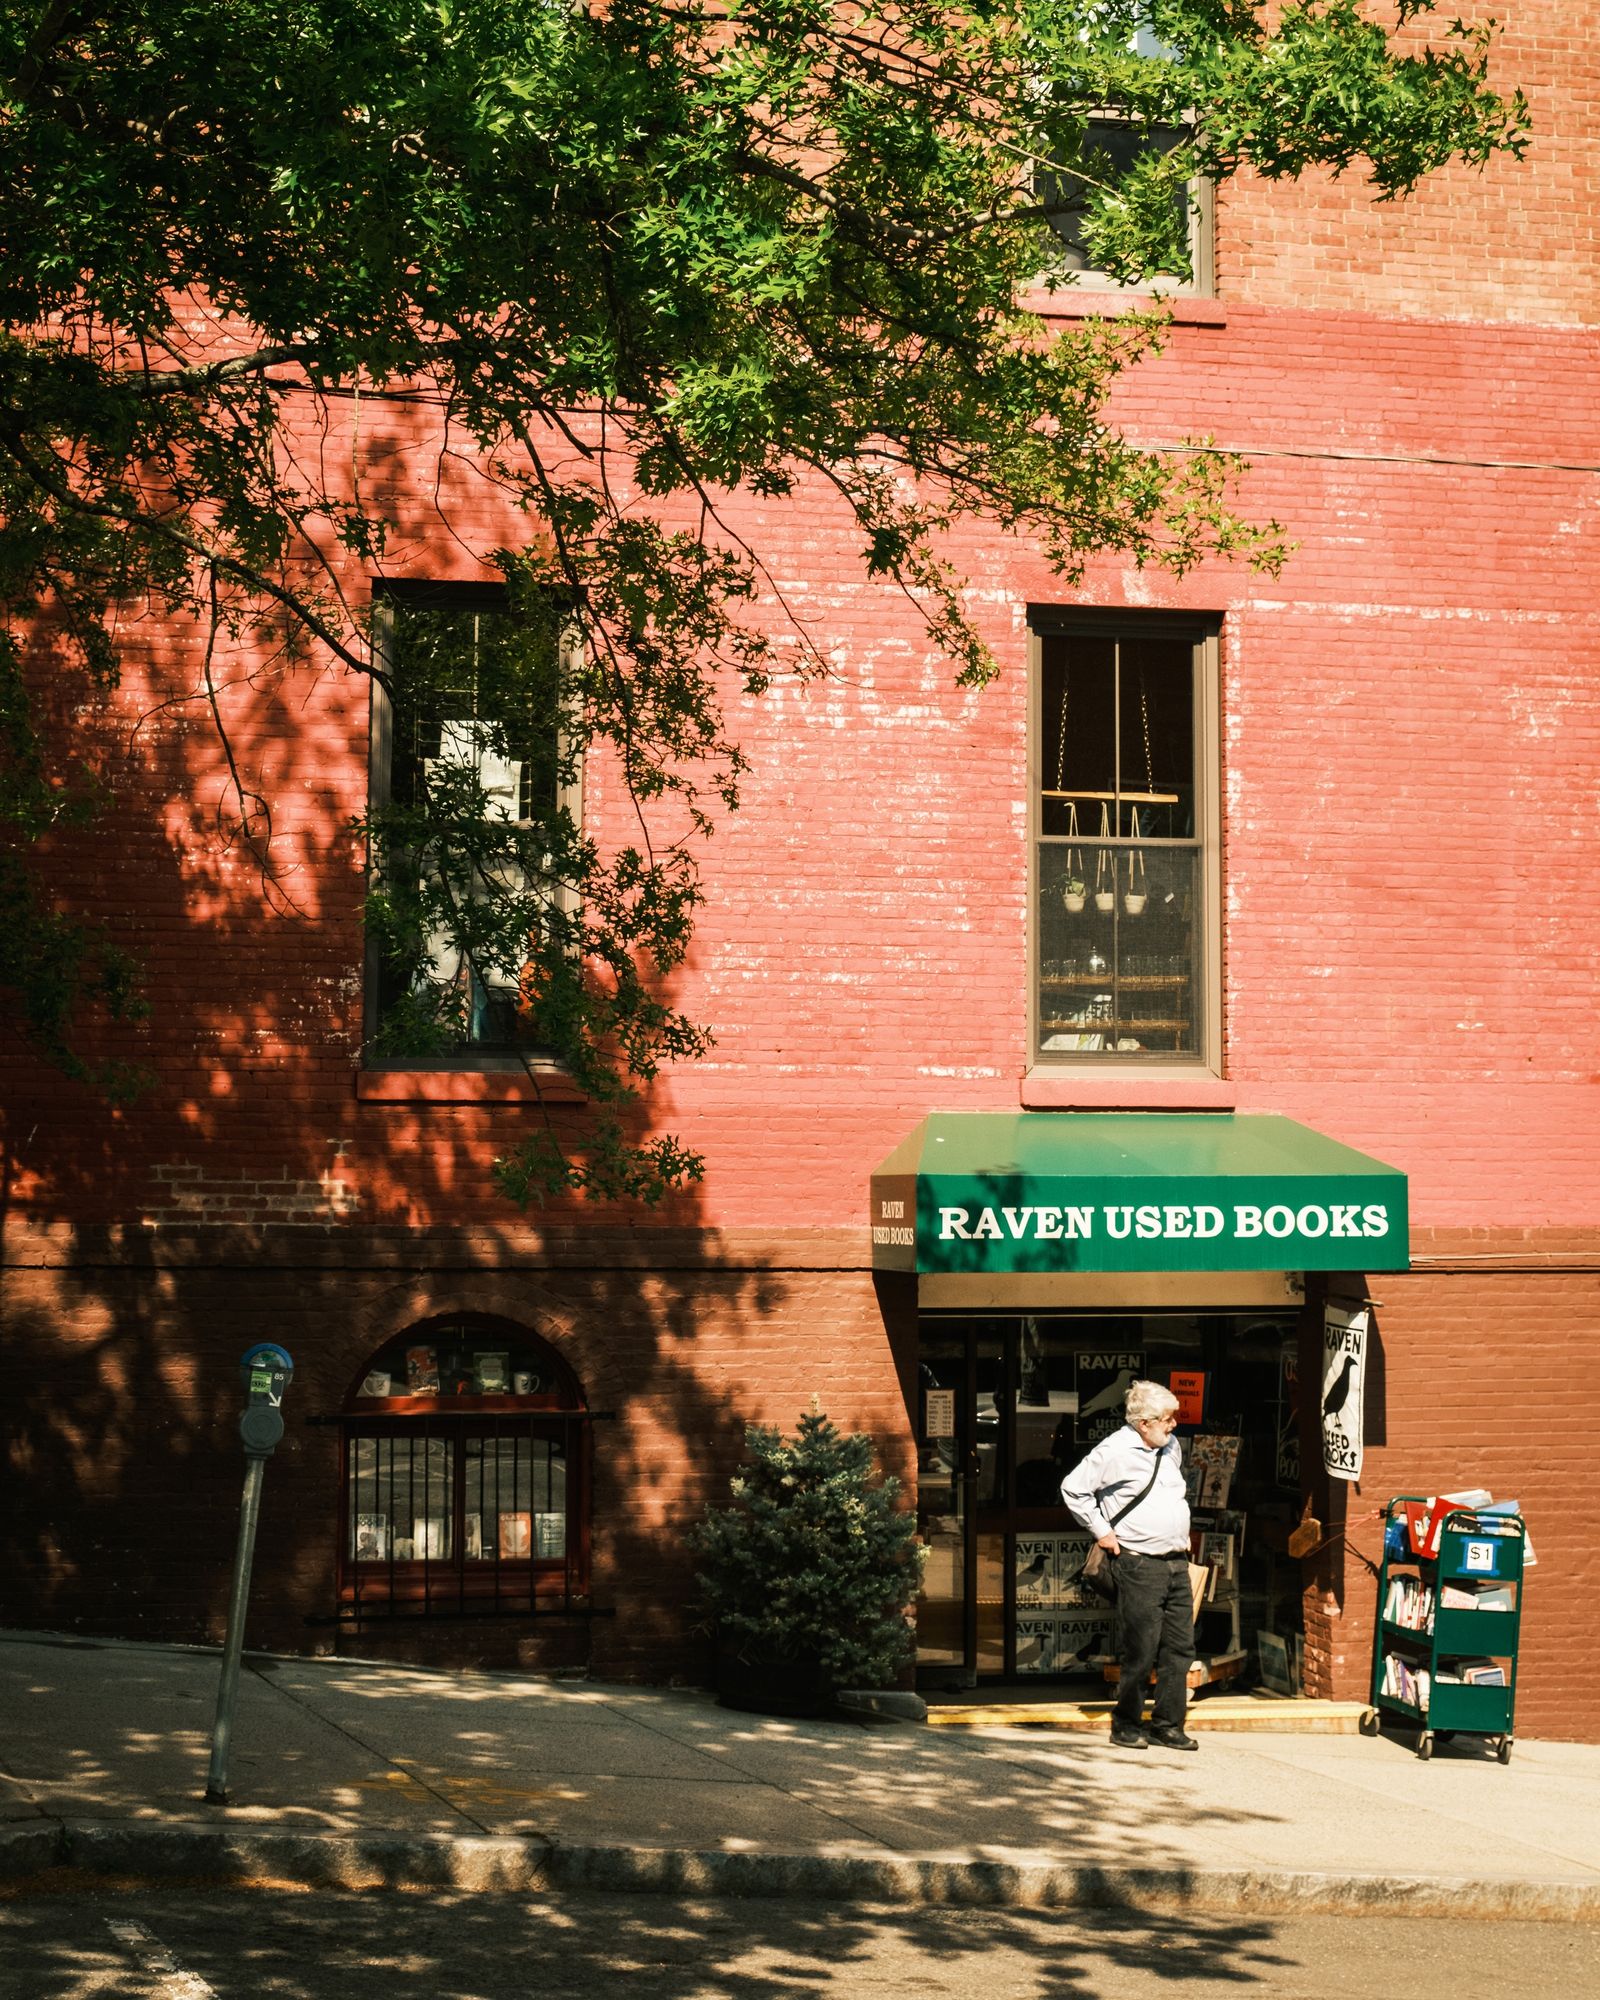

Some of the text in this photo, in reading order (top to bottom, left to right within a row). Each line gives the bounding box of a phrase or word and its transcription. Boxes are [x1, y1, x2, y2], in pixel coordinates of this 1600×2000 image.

[882, 1200, 904, 1219] RAVEN
[938, 1204, 1390, 1240] RAVEN USED BOOKS
[873, 1226, 914, 1246] USED BOOKS
[1326, 1327, 1361, 1354] RAVEN
[1079, 1354, 1141, 1370] RAVEN
[1178, 1379, 1196, 1387] NEW
[1279, 1455, 1300, 1480] BOO
[1016, 1542, 1052, 1554] AVEN
[1060, 1542, 1089, 1553] RAV
[1016, 1622, 1053, 1633] AVEN
[1061, 1622, 1109, 1634] RAVEN
